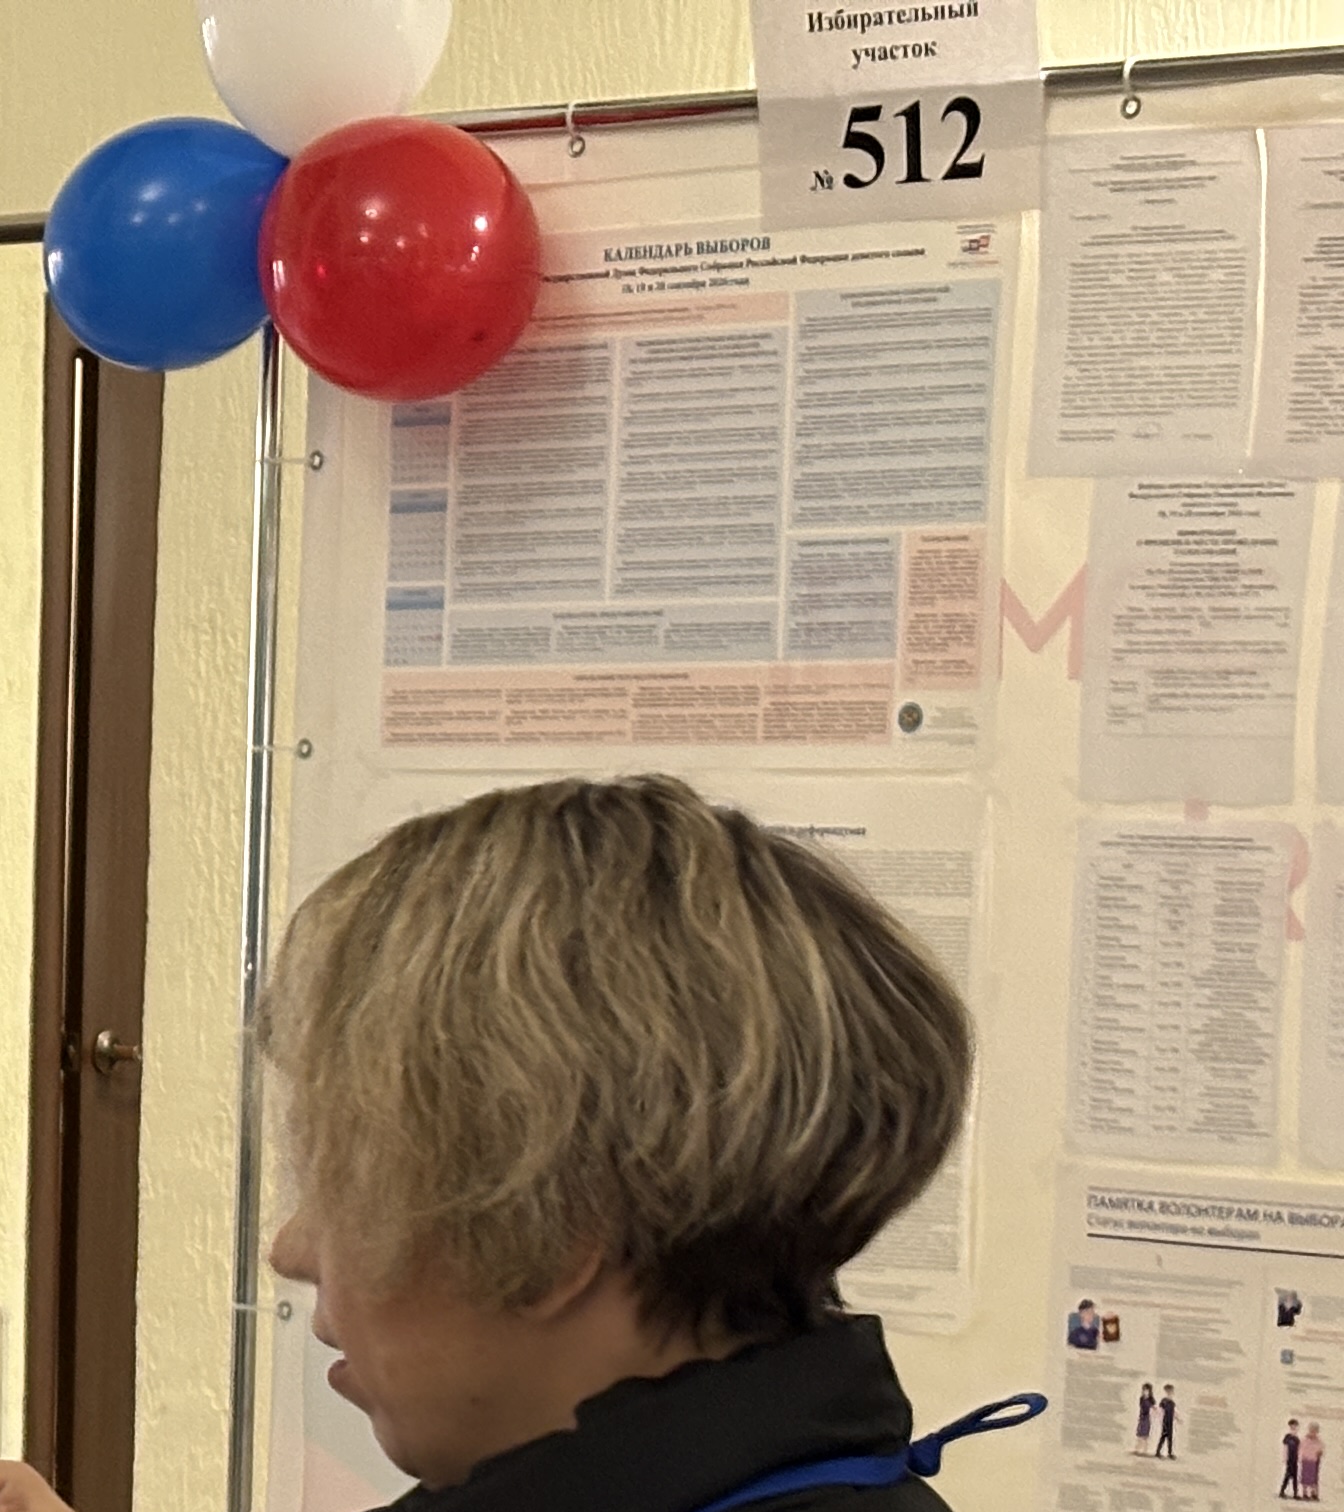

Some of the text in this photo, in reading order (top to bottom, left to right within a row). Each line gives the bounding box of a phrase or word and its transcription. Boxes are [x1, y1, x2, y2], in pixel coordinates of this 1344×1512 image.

[806, 0, 979, 33] Избирательный
[851, 40, 938, 69] участок
[810, 96, 986, 191] № 512
[603, 236, 771, 262] КАЛЕНДАРЬ ВЫБОРОВ
